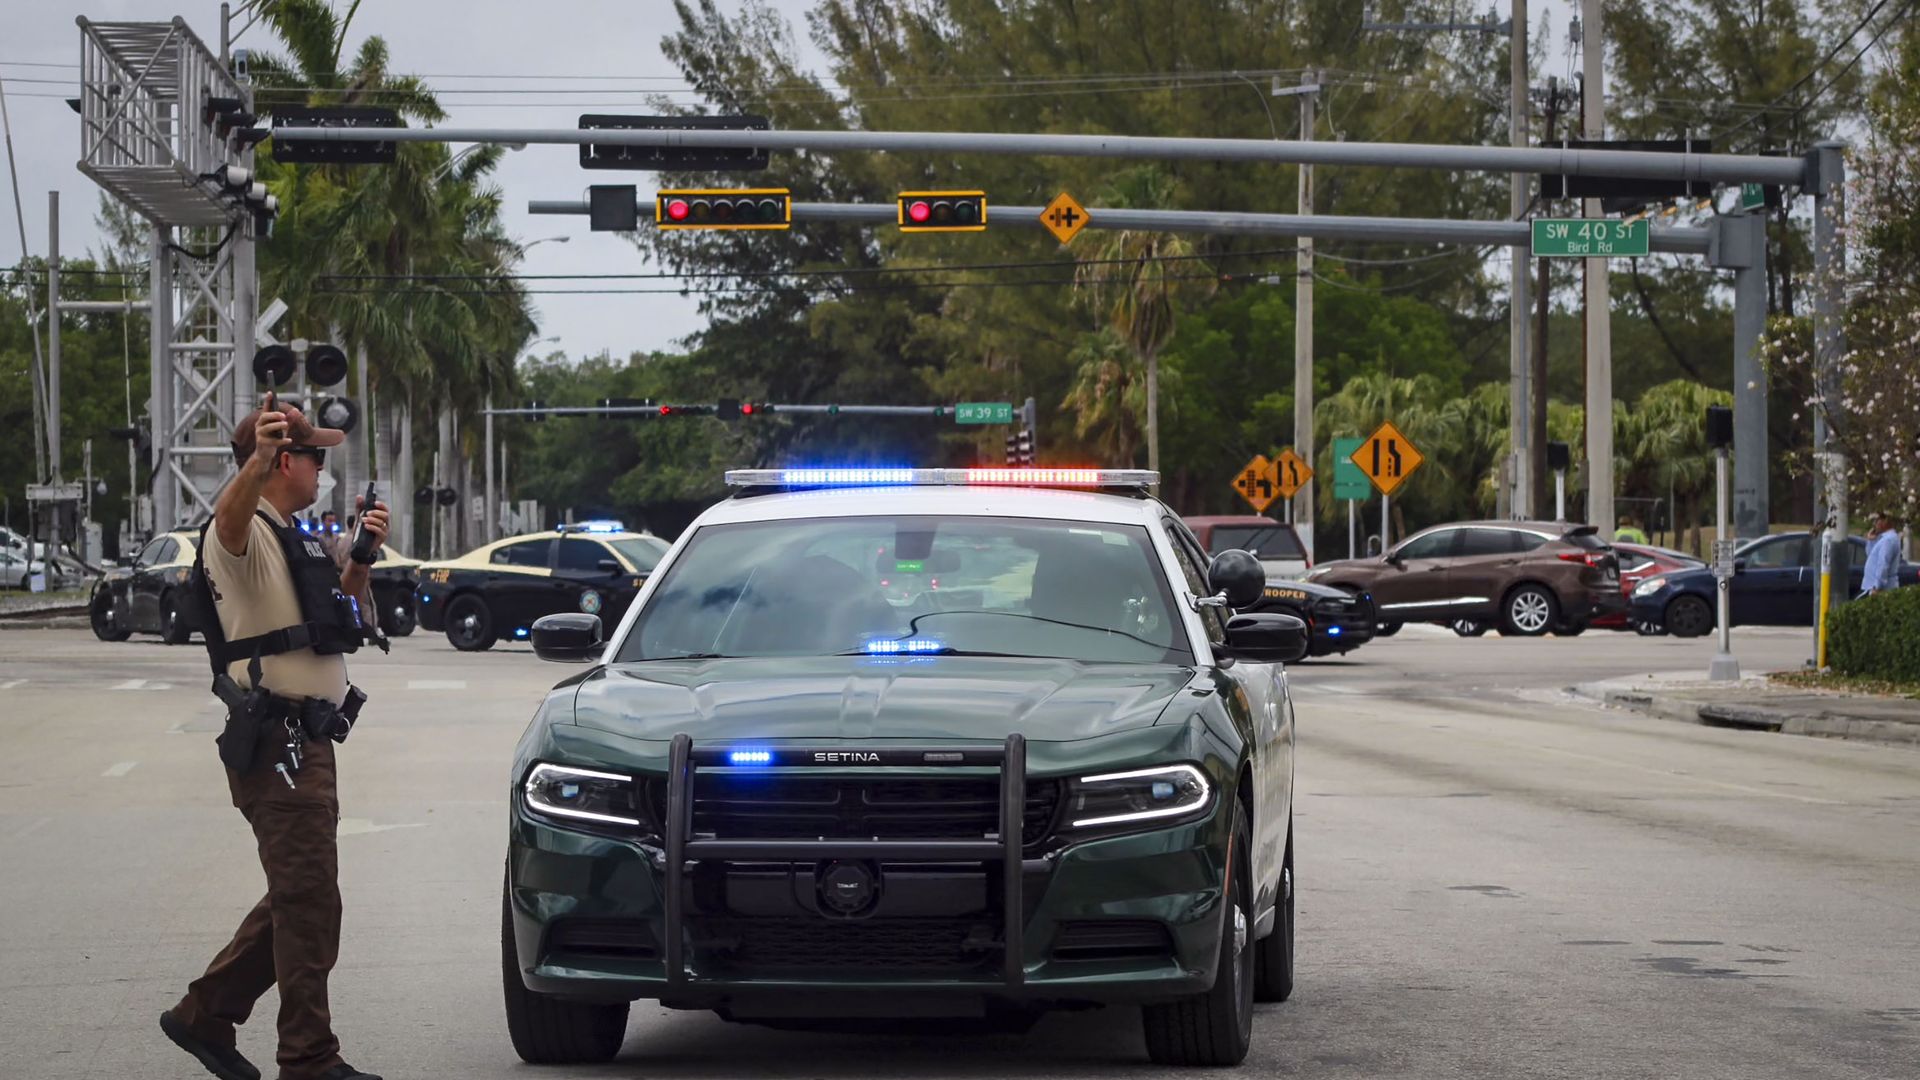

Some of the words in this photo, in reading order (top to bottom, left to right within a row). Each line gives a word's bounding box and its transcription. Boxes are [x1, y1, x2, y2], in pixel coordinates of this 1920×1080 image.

[1546, 223, 1569, 239] SW
[1578, 222, 1608, 240] 40
[1616, 223, 1635, 239] ST
[1567, 241, 1590, 253] Bird
[1598, 241, 1613, 253] Rd
[959, 408, 973, 419] SW
[977, 407, 992, 419] 39
[997, 408, 1008, 418] ST
[1264, 588, 1306, 600] ROOPER
[814, 752, 881, 762] SETINA
